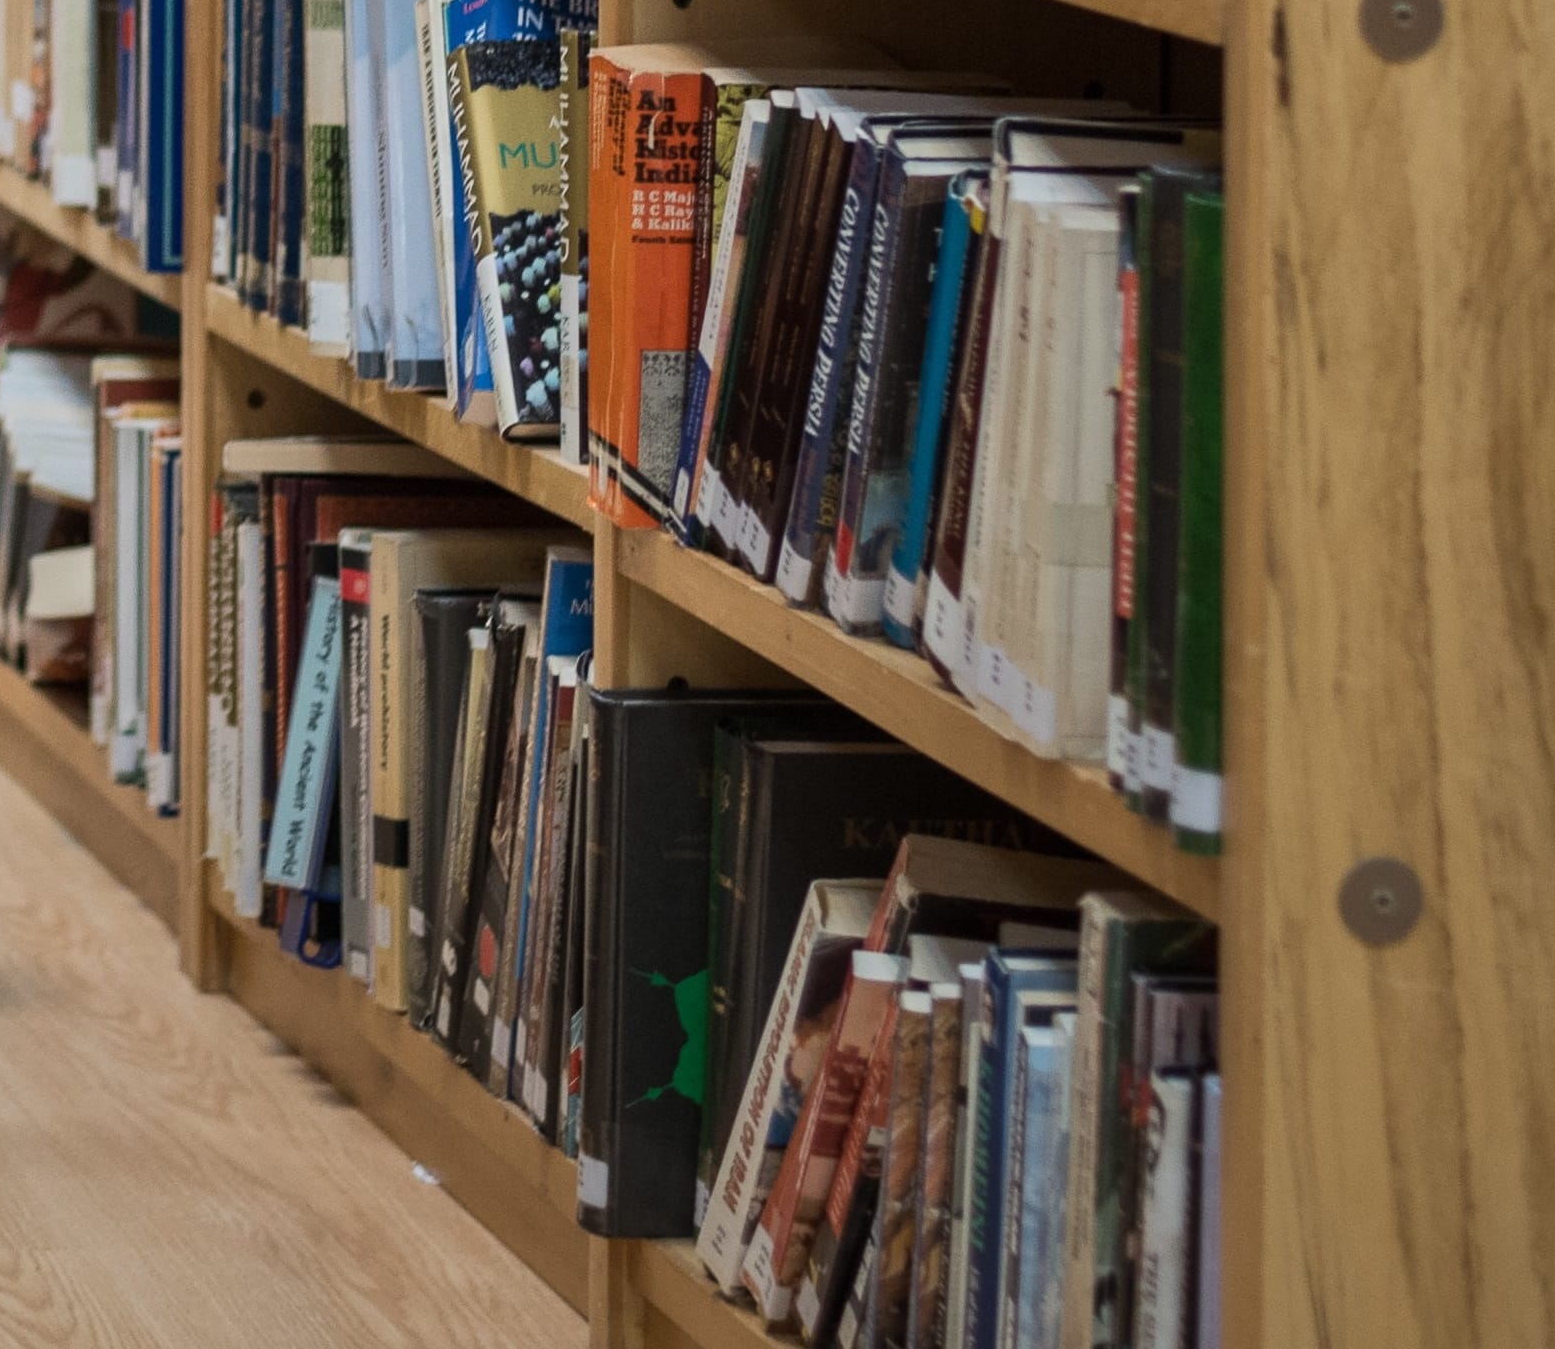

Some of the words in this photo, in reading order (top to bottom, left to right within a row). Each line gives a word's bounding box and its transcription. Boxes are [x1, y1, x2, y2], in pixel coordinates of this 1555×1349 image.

[516, 6, 544, 29] IN
[636, 90, 676, 112] An
[446, 62, 483, 257] MUHAMMAD
[480, 293, 499, 356] KAREN
[631, 204, 645, 217] H
[649, 204, 660, 217] C
[664, 205, 694, 220] Ray
[631, 218, 643, 231] &
[632, 190, 644, 203] R
[649, 190, 660, 203] C
[821, 187, 861, 346] CONVERTING
[852, 203, 892, 362] CONVERTING
[803, 347, 834, 438] PERSIA
[847, 365, 874, 456] PERSIA
[378, 612, 390, 670] World
[313, 670, 331, 694] of
[305, 701, 326, 734] the
[377, 672, 390, 771] prehistory
[291, 740, 319, 810] Ancient
[278, 817, 306, 878] World
[746, 992, 795, 1122] REVOLUTION
[738, 1121, 758, 1152] OF
[721, 1150, 752, 1215] IRAN
